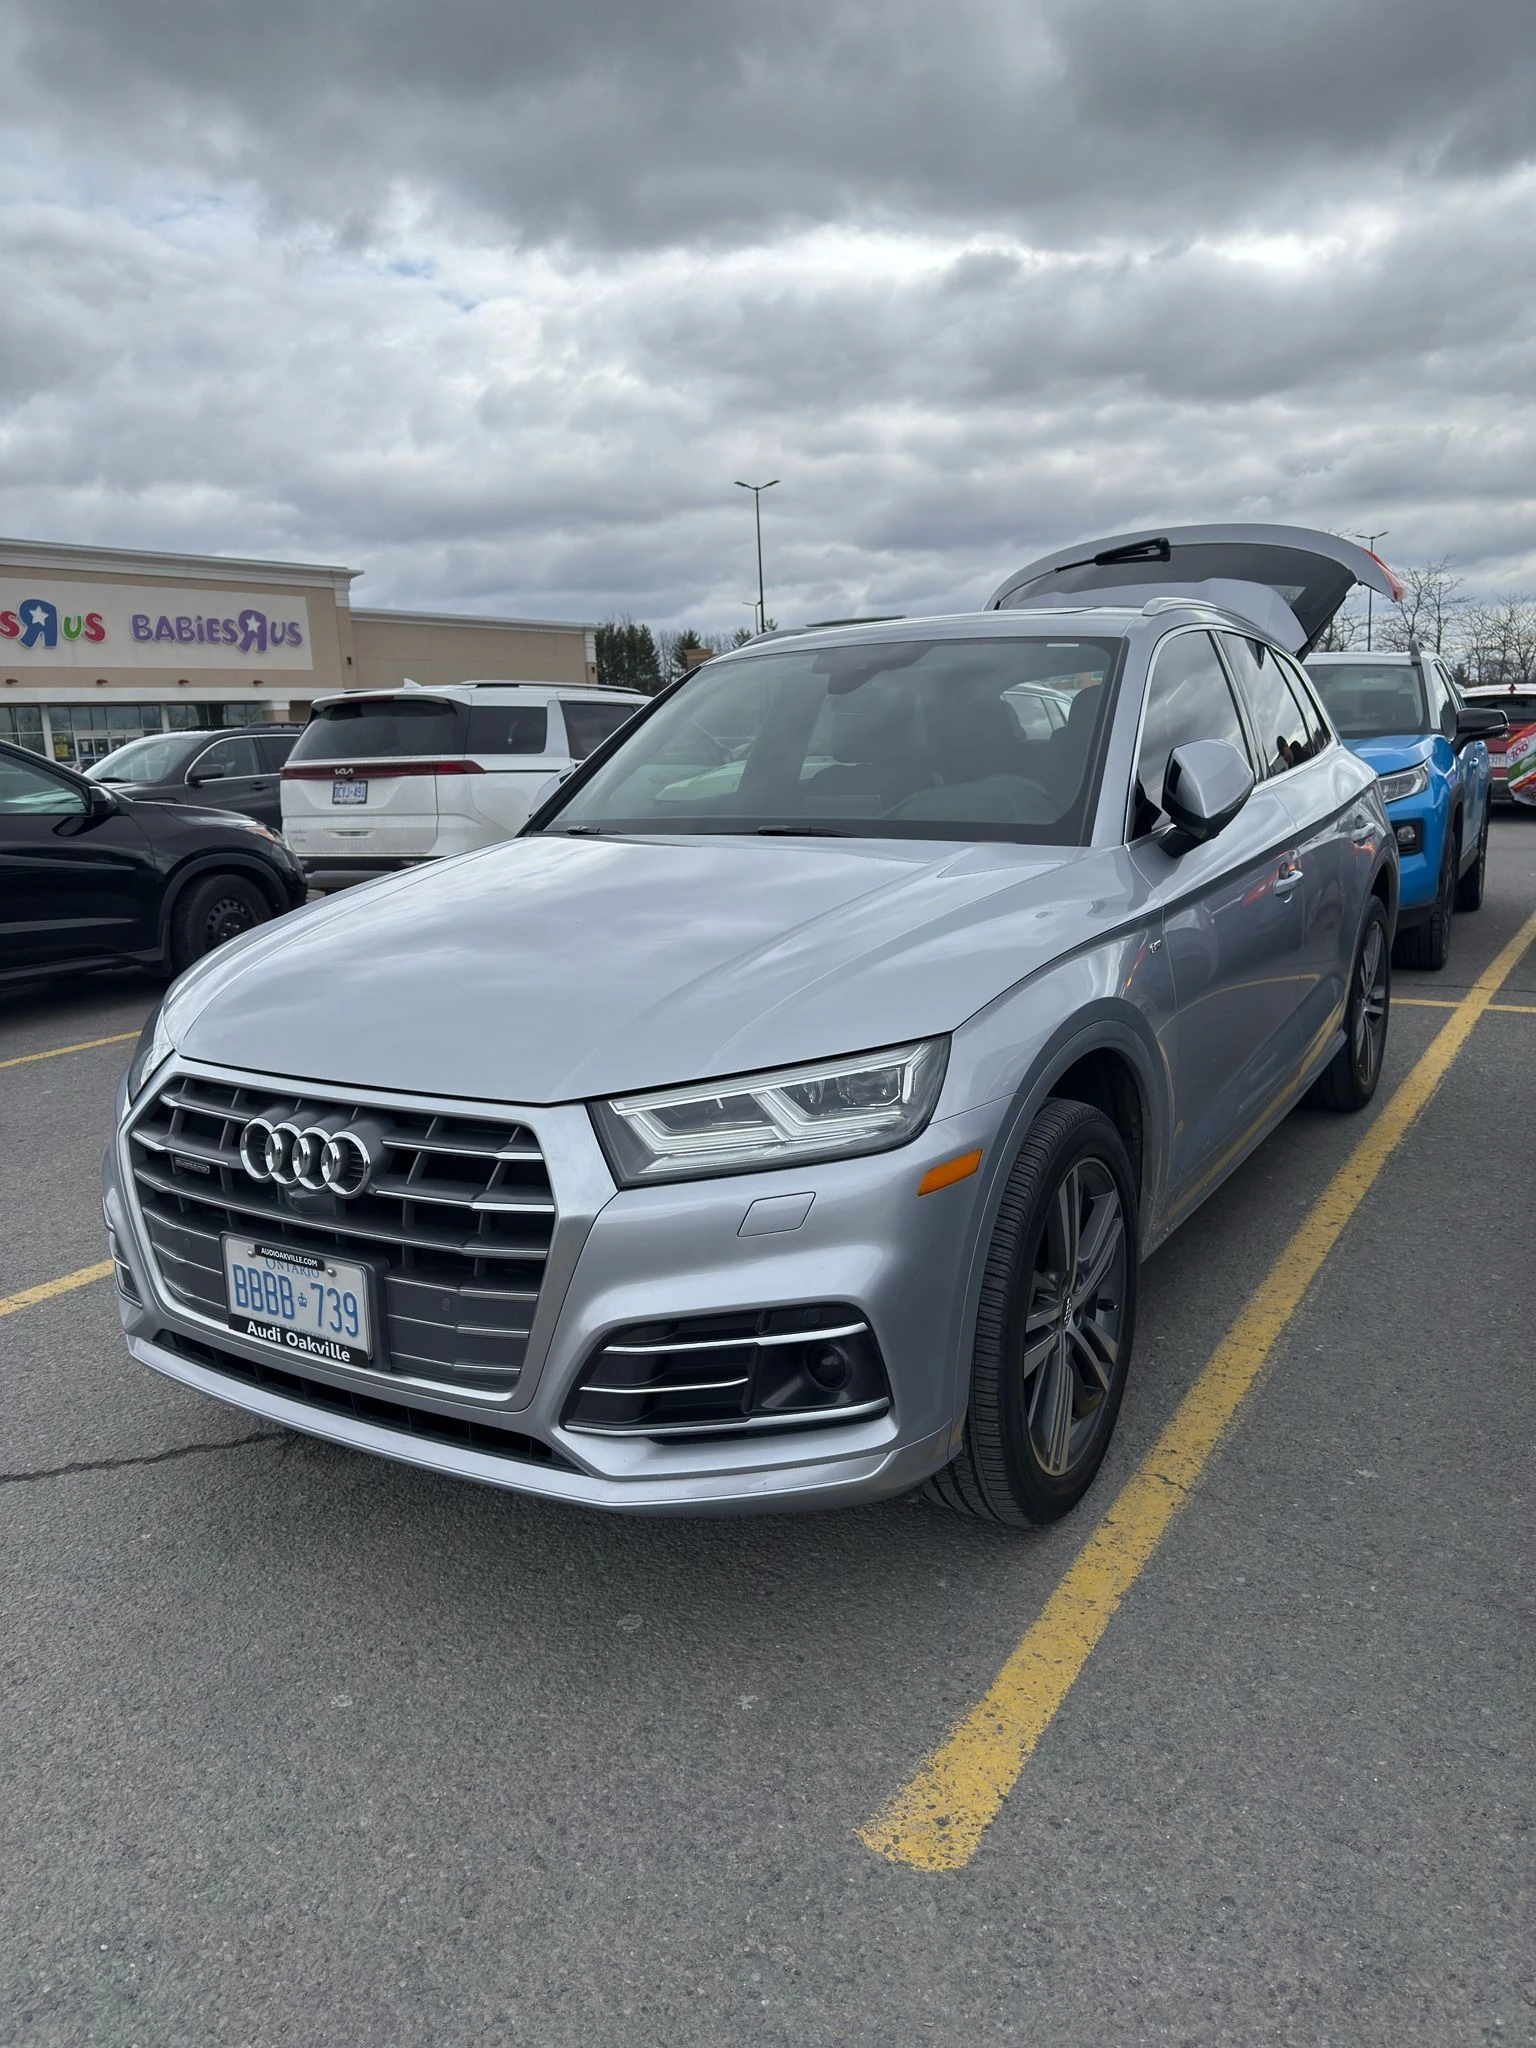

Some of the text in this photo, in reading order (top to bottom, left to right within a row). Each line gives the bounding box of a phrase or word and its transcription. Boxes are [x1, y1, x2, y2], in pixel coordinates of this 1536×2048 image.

[260, 1247, 318, 1267] AUDIOAKVILLE.COM
[265, 1257, 320, 1279] ONTARIO
[232, 1263, 359, 1338] BBBB 739
[247, 1320, 351, 1363] Audi Oakville
